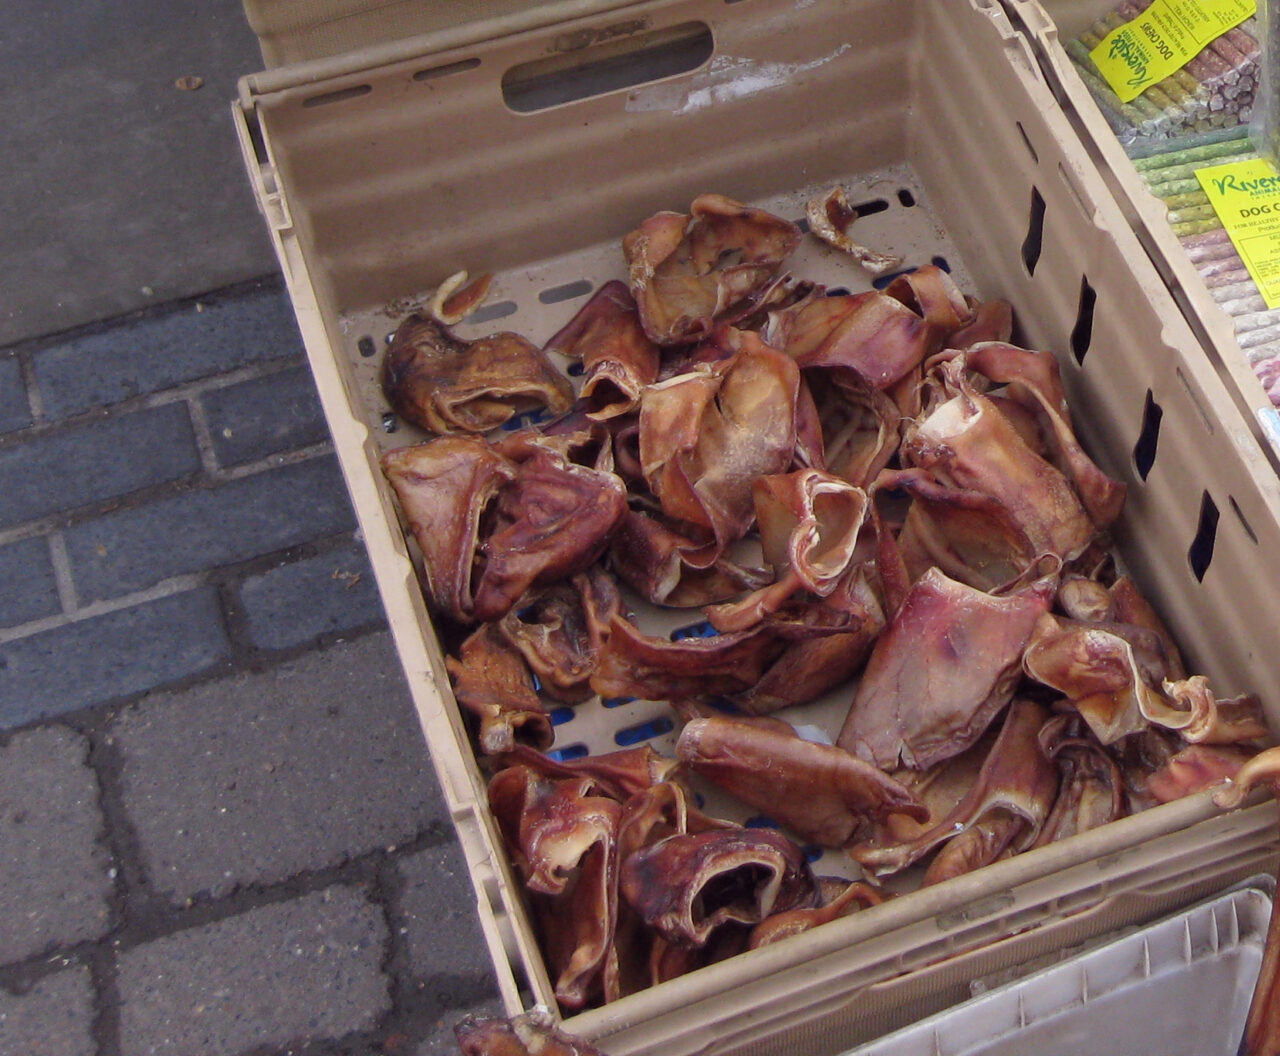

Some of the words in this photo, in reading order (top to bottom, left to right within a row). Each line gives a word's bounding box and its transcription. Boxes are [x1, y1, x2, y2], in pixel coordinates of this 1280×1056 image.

[1140, 22, 1160, 43] CHEWS
[1156, 40, 1174, 60] DOG
[1240, 205, 1271, 218] DOG
